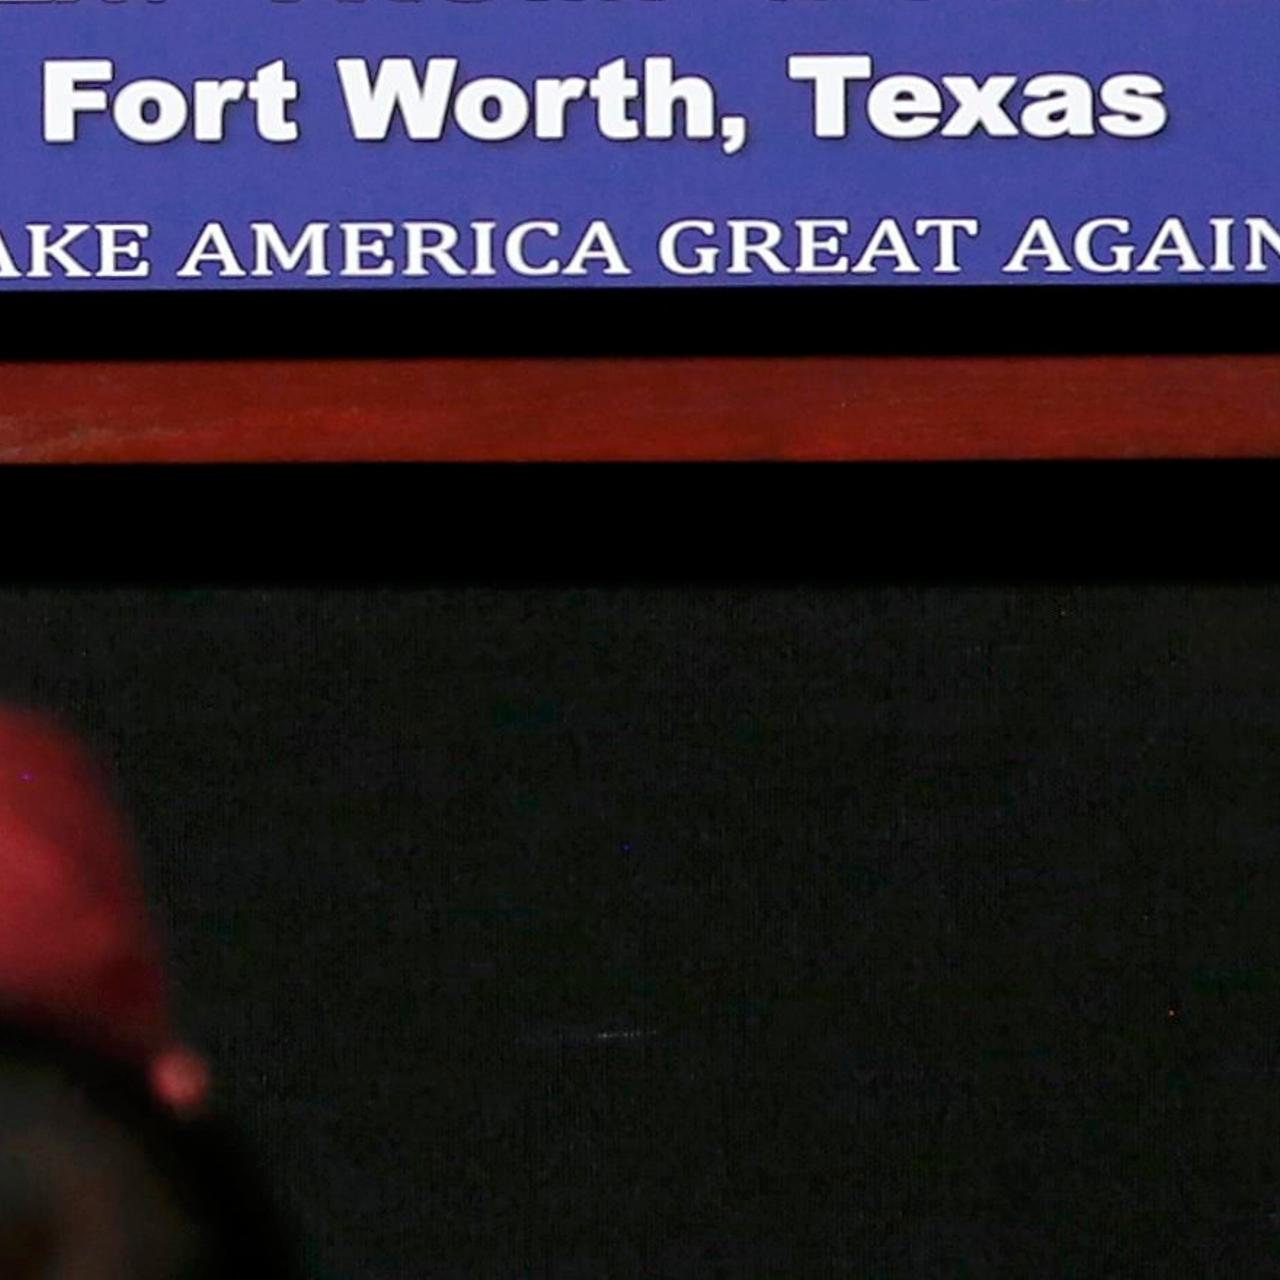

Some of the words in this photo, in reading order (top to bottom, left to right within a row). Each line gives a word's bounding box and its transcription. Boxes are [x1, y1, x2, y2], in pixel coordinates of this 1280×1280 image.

[43, 59, 298, 142] Fort
[337, 57, 747, 154] Worth,
[789, 55, 1168, 138] Texas
[176, 221, 632, 277] AMERICA
[658, 219, 978, 275] GREAT
